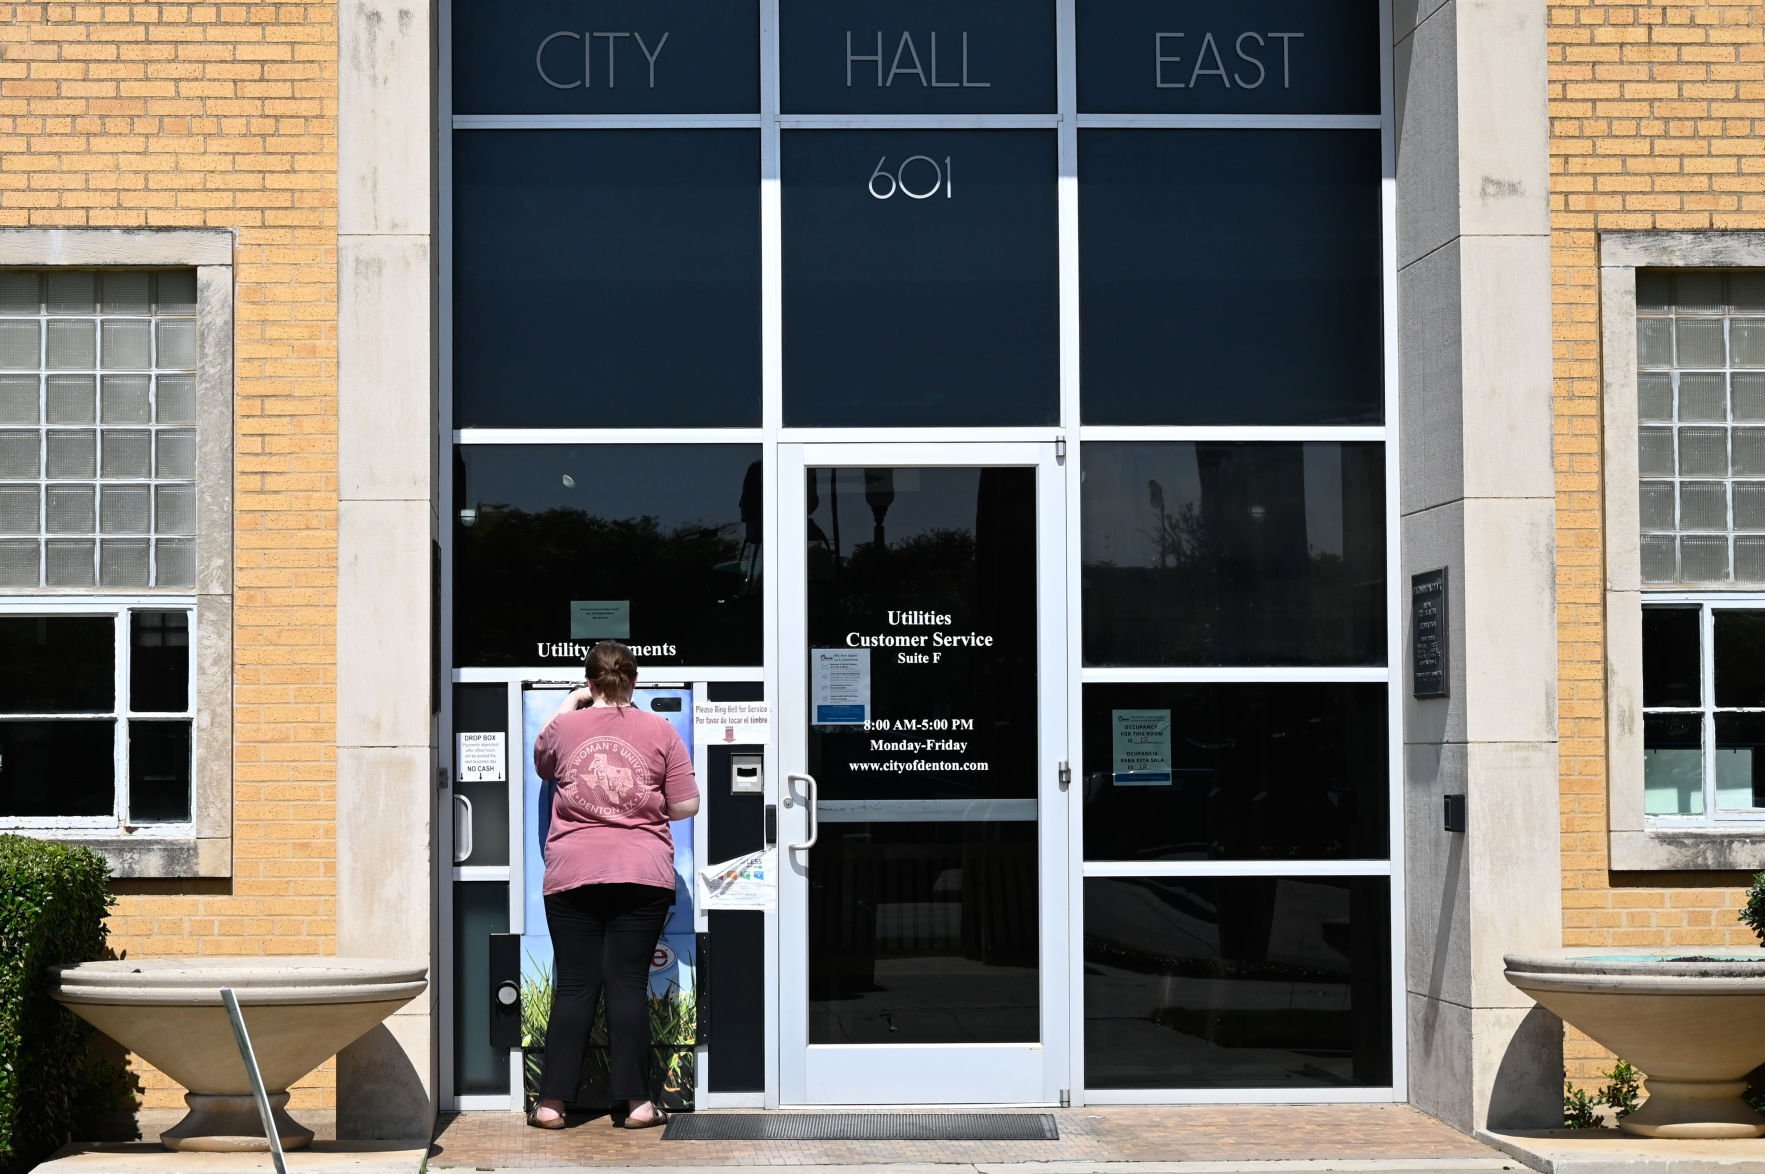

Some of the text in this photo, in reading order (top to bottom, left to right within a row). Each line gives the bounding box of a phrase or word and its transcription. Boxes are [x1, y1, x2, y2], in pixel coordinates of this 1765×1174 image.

[536, 31, 1305, 89] CITY HALL EAST
[868, 155, 952, 199] 601
[888, 610, 952, 626] Utilities
[846, 632, 993, 647] Customer Service
[537, 642, 590, 661] Utility
[897, 652, 942, 663] Suite F
[696, 705, 713, 713] Please
[714, 705, 726, 715] Ring
[728, 705, 737, 713] Bell
[748, 705, 768, 713] Service
[706, 717, 719, 725] favor
[750, 716, 768, 724] timbre
[863, 719, 974, 731] 8:00 AM-5:00 PM
[870, 739, 967, 753] Monday-Friday
[573, 742, 619, 766] WOMAN'S
[849, 760, 989, 773] www.cityofdenton.com
[623, 800, 636, 810] TX
